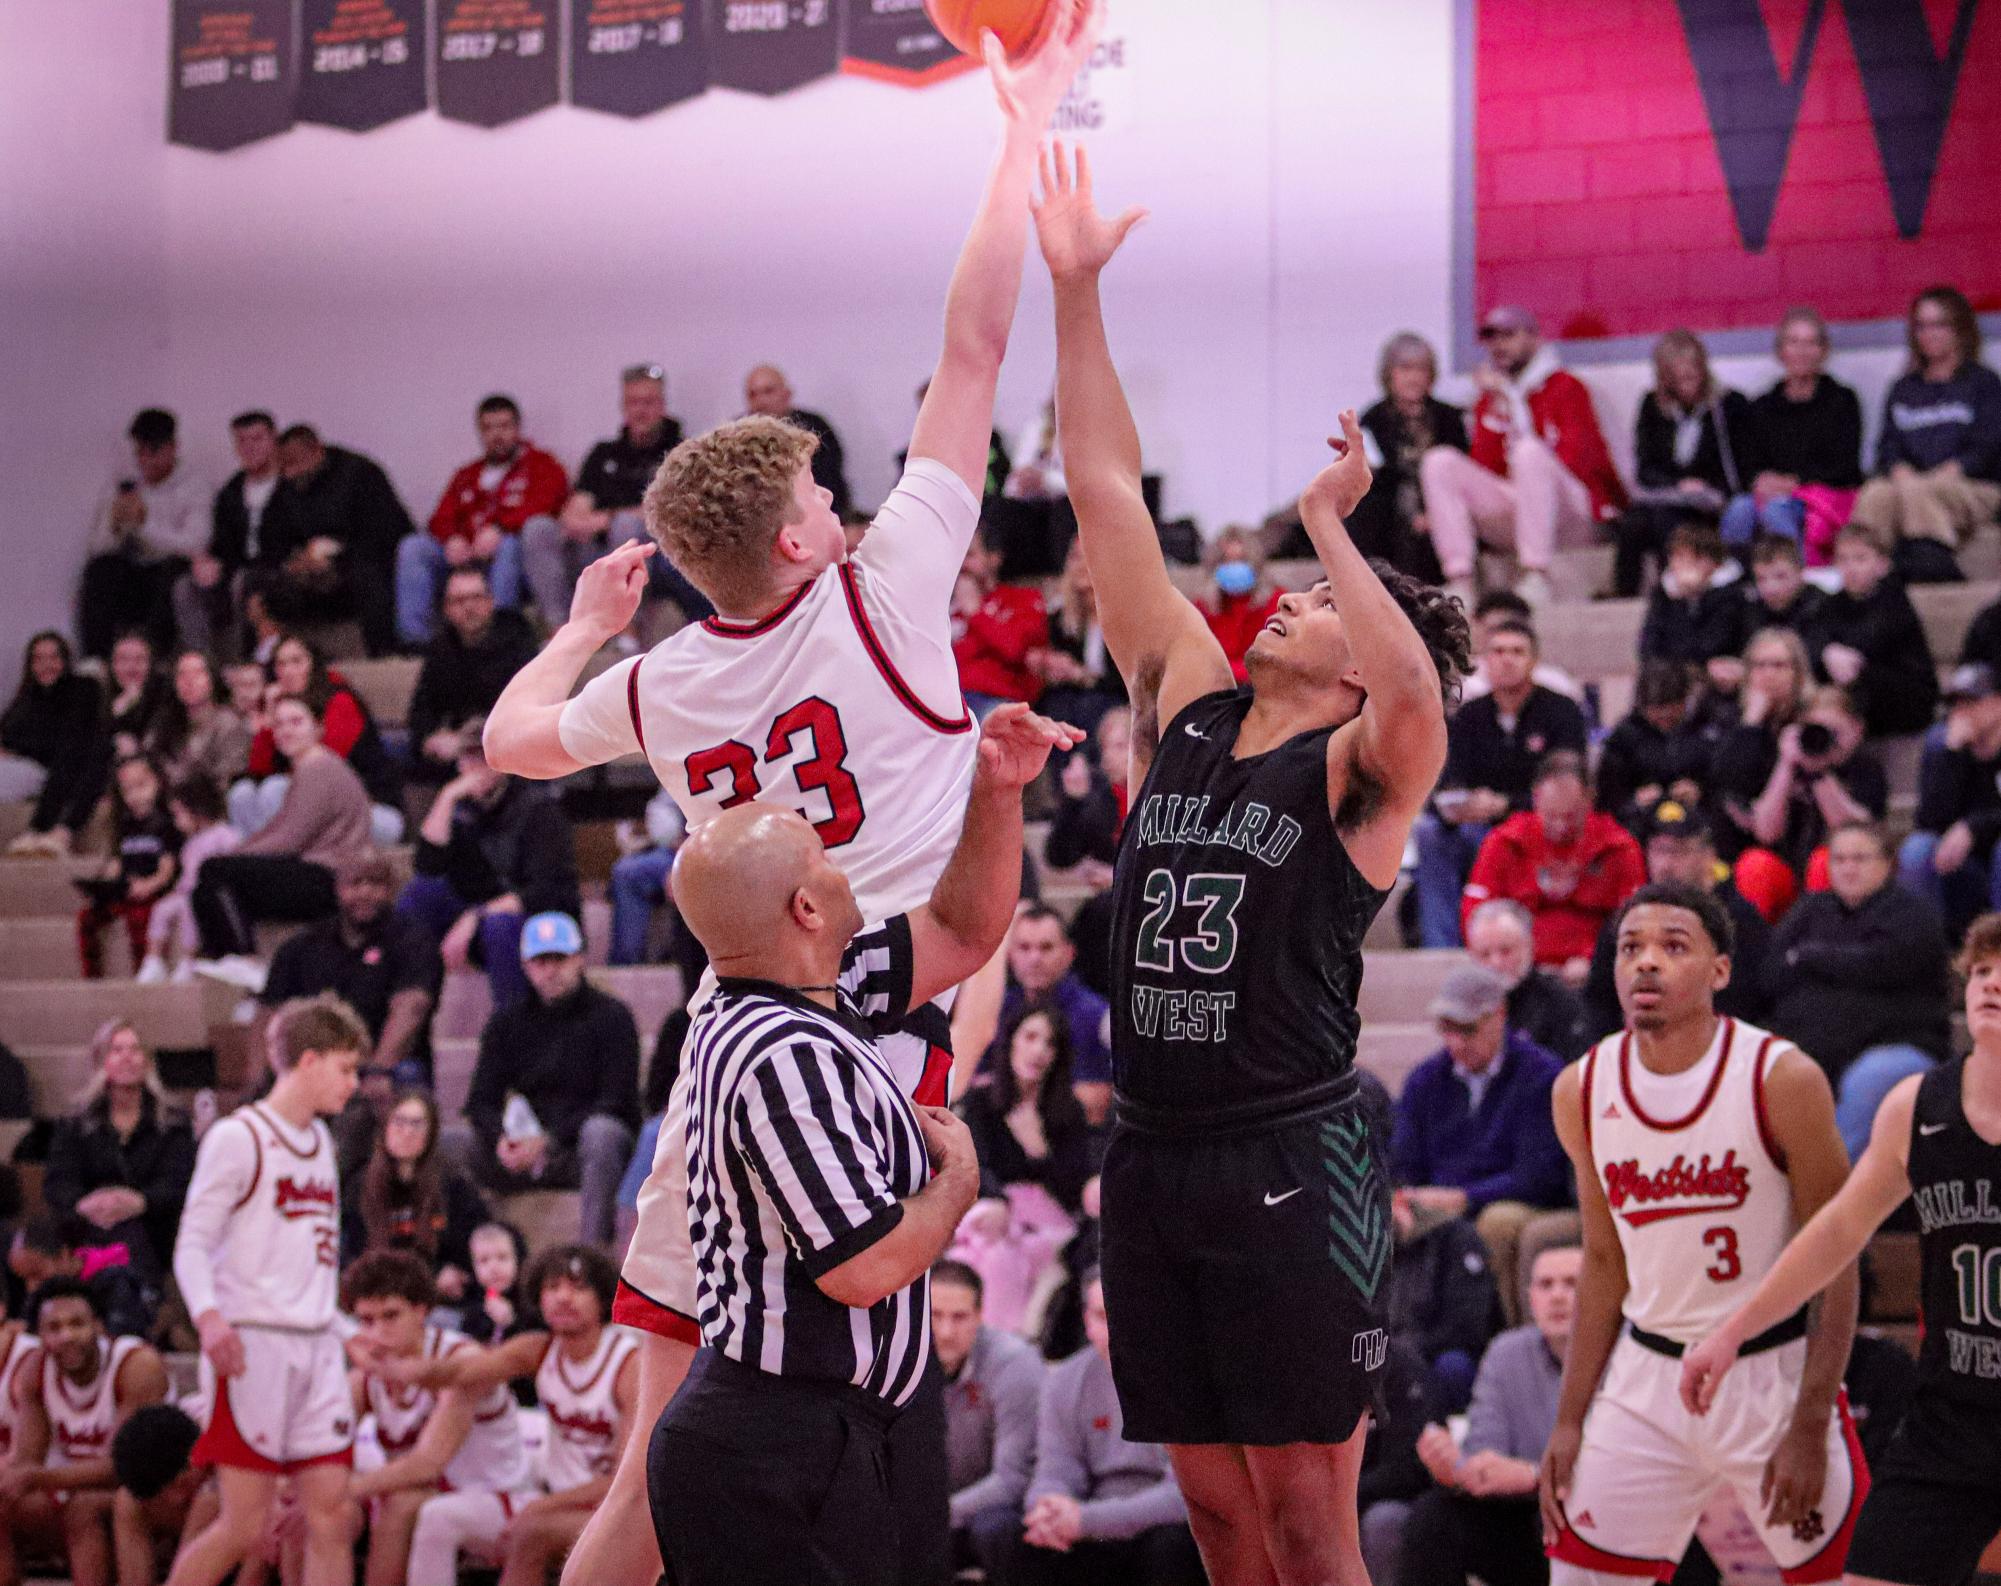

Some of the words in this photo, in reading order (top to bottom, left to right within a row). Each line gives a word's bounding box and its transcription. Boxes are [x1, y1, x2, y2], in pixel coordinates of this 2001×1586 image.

[1136, 794, 1302, 868] MILLARD
[1135, 867, 1247, 975] 23
[1131, 984, 1236, 1044] WEST
[1702, 1225, 1742, 1284] 3
